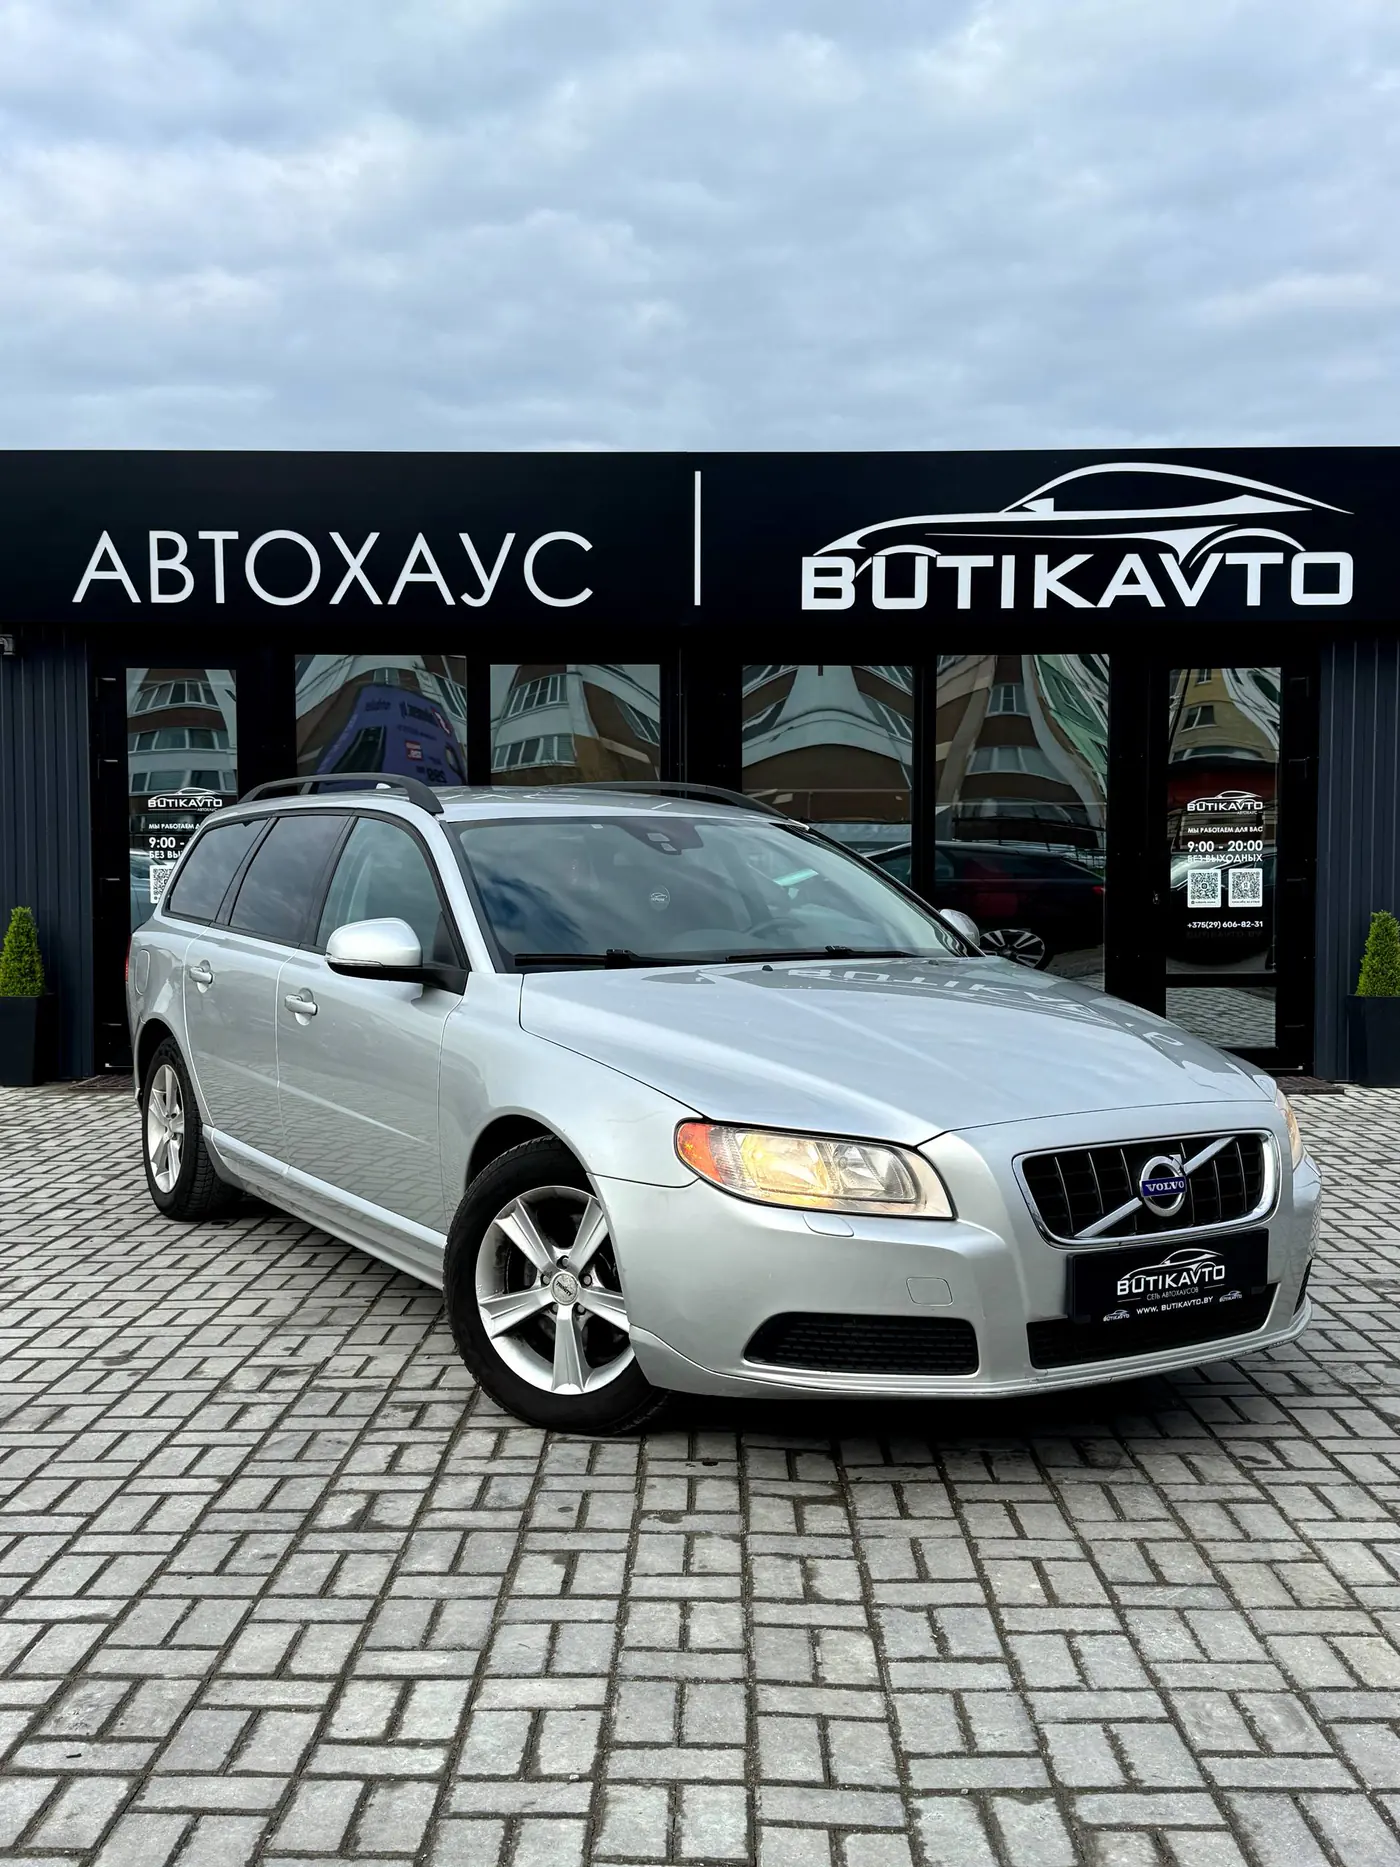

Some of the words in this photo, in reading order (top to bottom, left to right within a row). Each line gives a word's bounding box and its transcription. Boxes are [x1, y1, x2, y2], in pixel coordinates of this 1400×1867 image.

[71, 529, 594, 608] АВТОХАУС
[801, 550, 1355, 610] BUTIKAVTO
[147, 798, 223, 808] BUTIKAVTO
[1186, 801, 1264, 812] BUTIKAVTO
[148, 837, 176, 848] 9:00
[1187, 840, 1215, 852] 9:00
[1227, 840, 1263, 852] 20:00
[149, 850, 165, 859] БЕЗ
[1187, 854, 1205, 863] БЕЗ
[1205, 853, 1263, 863] ВЫХОДНЫХ
[1187, 920, 1221, 929] +375(29)
[1222, 920, 1264, 928] 606-82-31
[1145, 1180, 1185, 1192] VOLVO
[1117, 1265, 1226, 1296] BUTIKAVTO
[1146, 1292, 1161, 1301] СЕТЬ
[1161, 1286, 1199, 1299] АВТОХАУСОВ
[1136, 1305, 1159, 1315] WWW.
[1161, 1296, 1214, 1312] BUTIKAVTO.BY
